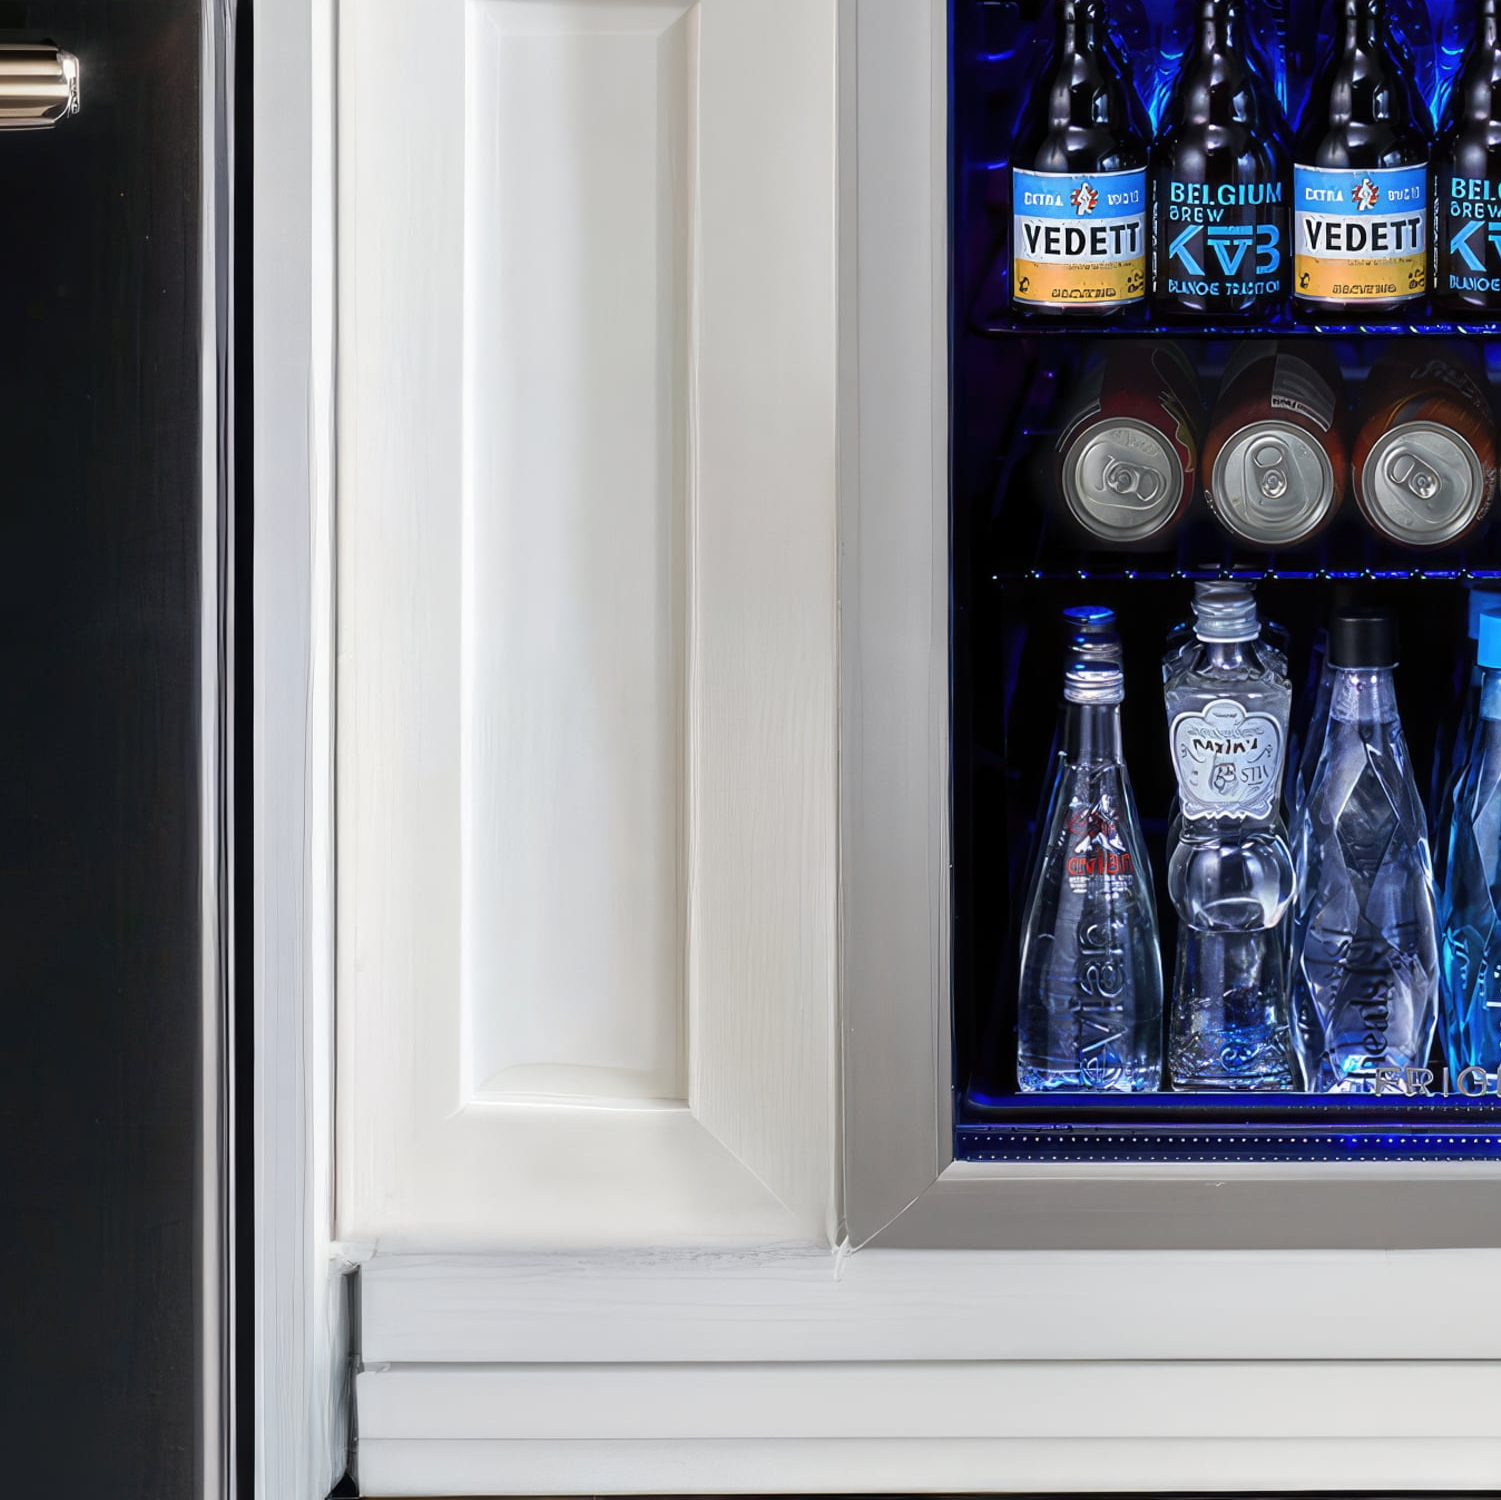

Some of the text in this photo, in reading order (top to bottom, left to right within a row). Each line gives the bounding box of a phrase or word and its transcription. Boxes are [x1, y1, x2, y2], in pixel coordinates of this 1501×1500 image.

[1169, 181, 1283, 206] BELGIUM
[1023, 221, 1140, 256] VEDETT
[1304, 217, 1422, 252] VEDETT
